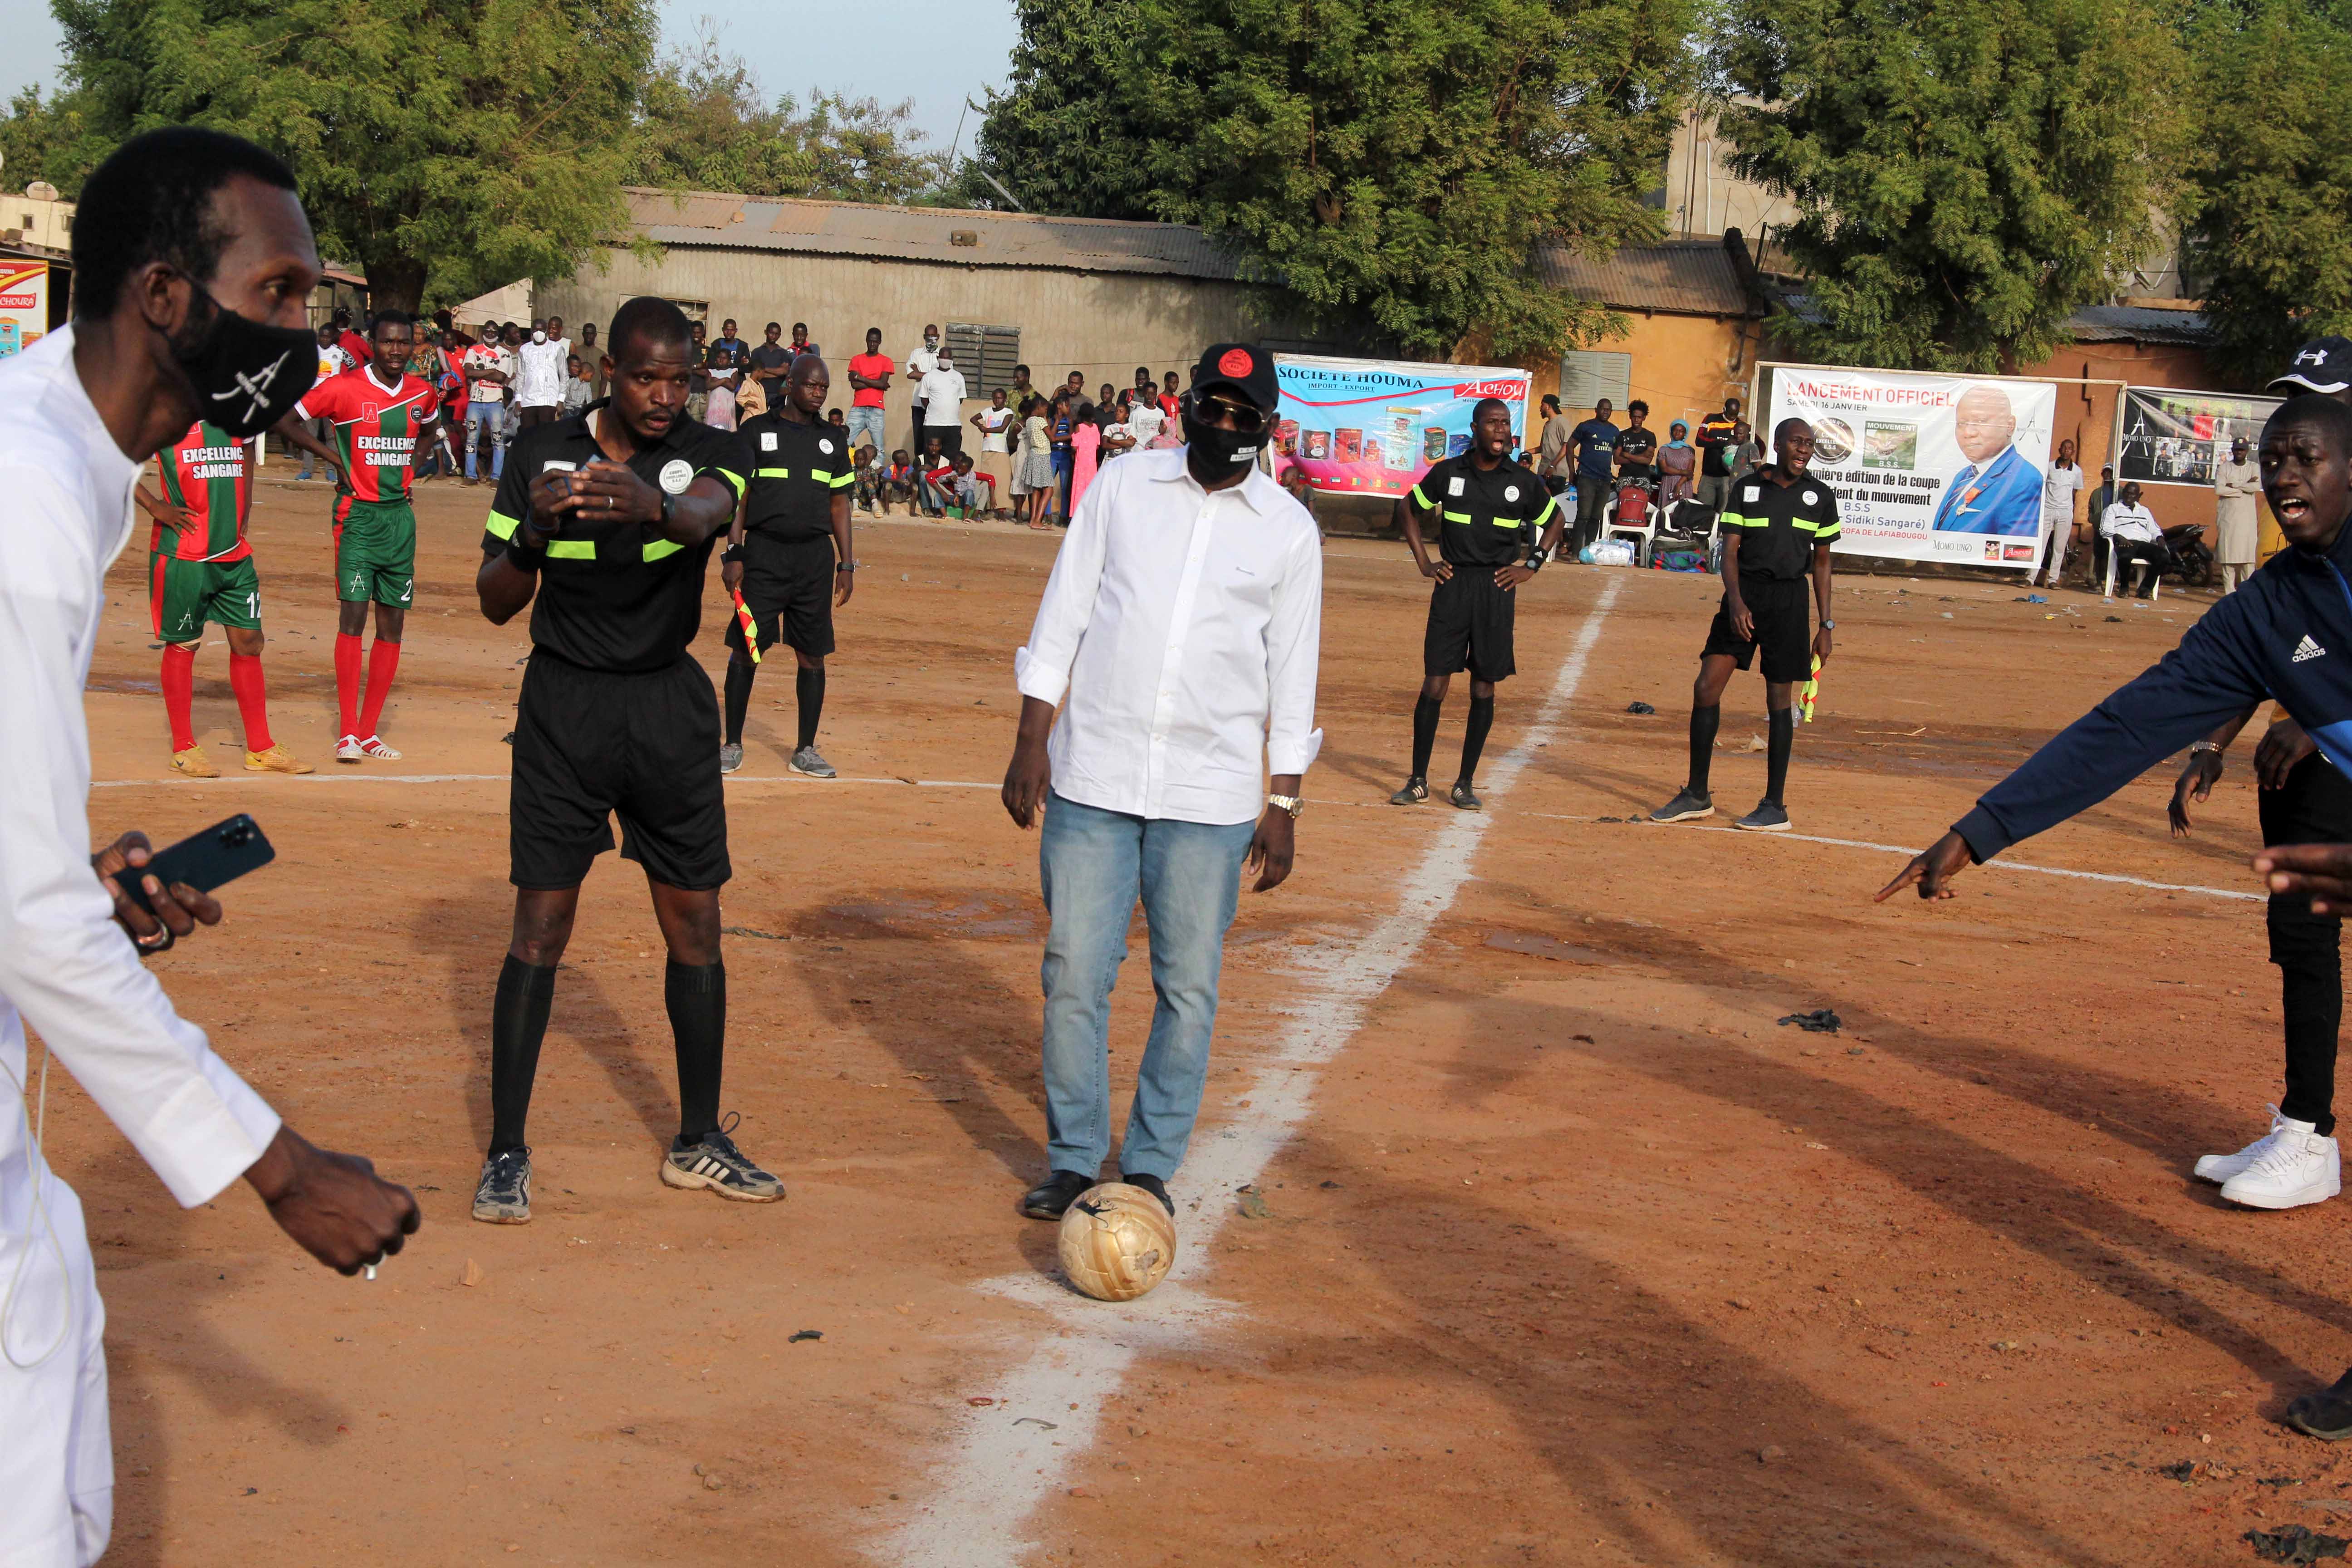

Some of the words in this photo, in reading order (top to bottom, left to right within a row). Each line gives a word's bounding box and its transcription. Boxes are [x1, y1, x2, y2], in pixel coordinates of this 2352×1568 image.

[0, 297, 34, 306] CHOURA
[1279, 367, 1351, 382] SOCIETE
[1357, 374, 1424, 388] HOUMA
[1455, 379, 1524, 397] ACHOU
[1787, 382, 1882, 402] LANCEMENT
[1886, 389, 1955, 407] OFFICIEL
[1787, 399, 1818, 407] SAMEDI
[1831, 403, 1867, 411] JANVIER
[1867, 422, 1916, 431] MOUVEMENT
[2123, 433, 2138, 441] MOMO
[182, 446, 244, 463] EXCELLENC
[365, 452, 412, 466] SANGARE
[193, 464, 243, 479] SANGARE
[1811, 468, 1842, 481] mière
[1845, 470, 1880, 484] édition
[1883, 473, 1895, 485] de
[1898, 474, 1908, 486] la
[1910, 477, 1940, 490] coupe
[1831, 486, 1853, 500] dent
[1857, 489, 1868, 501] du
[1871, 492, 1931, 505] mouvement
[1844, 502, 1870, 512] B.S.S
[1845, 514, 1874, 524] Sidiki
[1877, 517, 1925, 529] Sangaré)
[1874, 529, 1928, 539] LAFIABOUGOU
[1933, 539, 1954, 550] MOMO
[400, 578, 412, 601] 2
[2292, 648, 2326, 662] adidas
